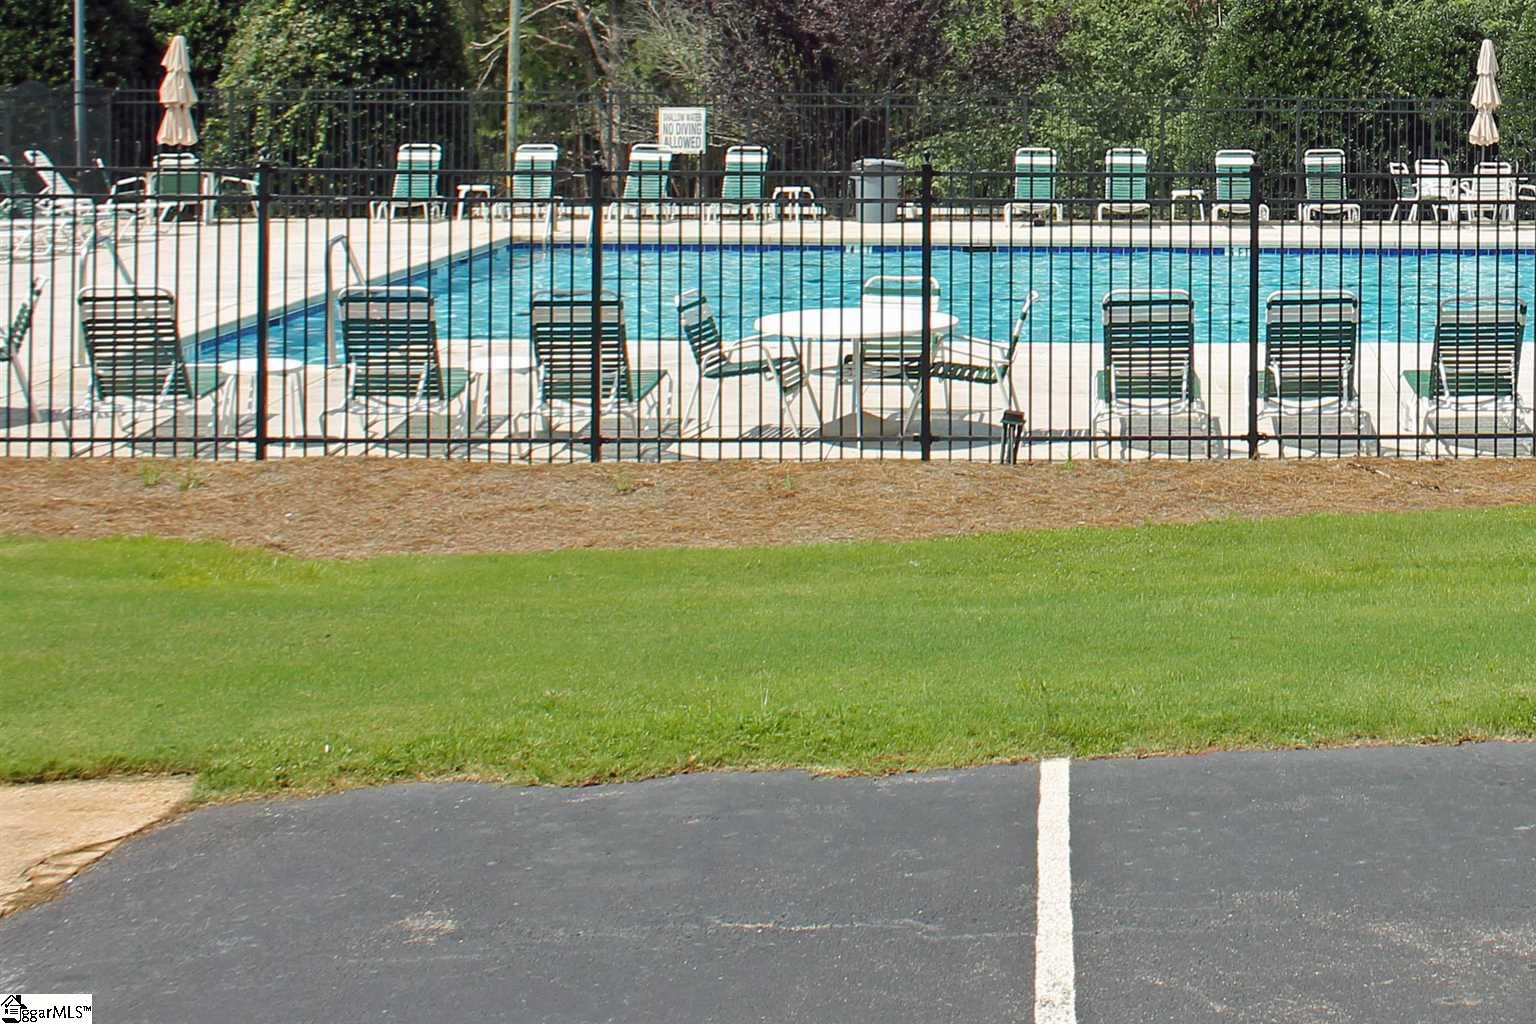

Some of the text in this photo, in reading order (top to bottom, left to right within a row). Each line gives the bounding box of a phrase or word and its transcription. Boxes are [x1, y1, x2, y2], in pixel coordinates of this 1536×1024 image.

[663, 122, 702, 135] NO DIVING
[664, 136, 702, 148] ALLOWED
